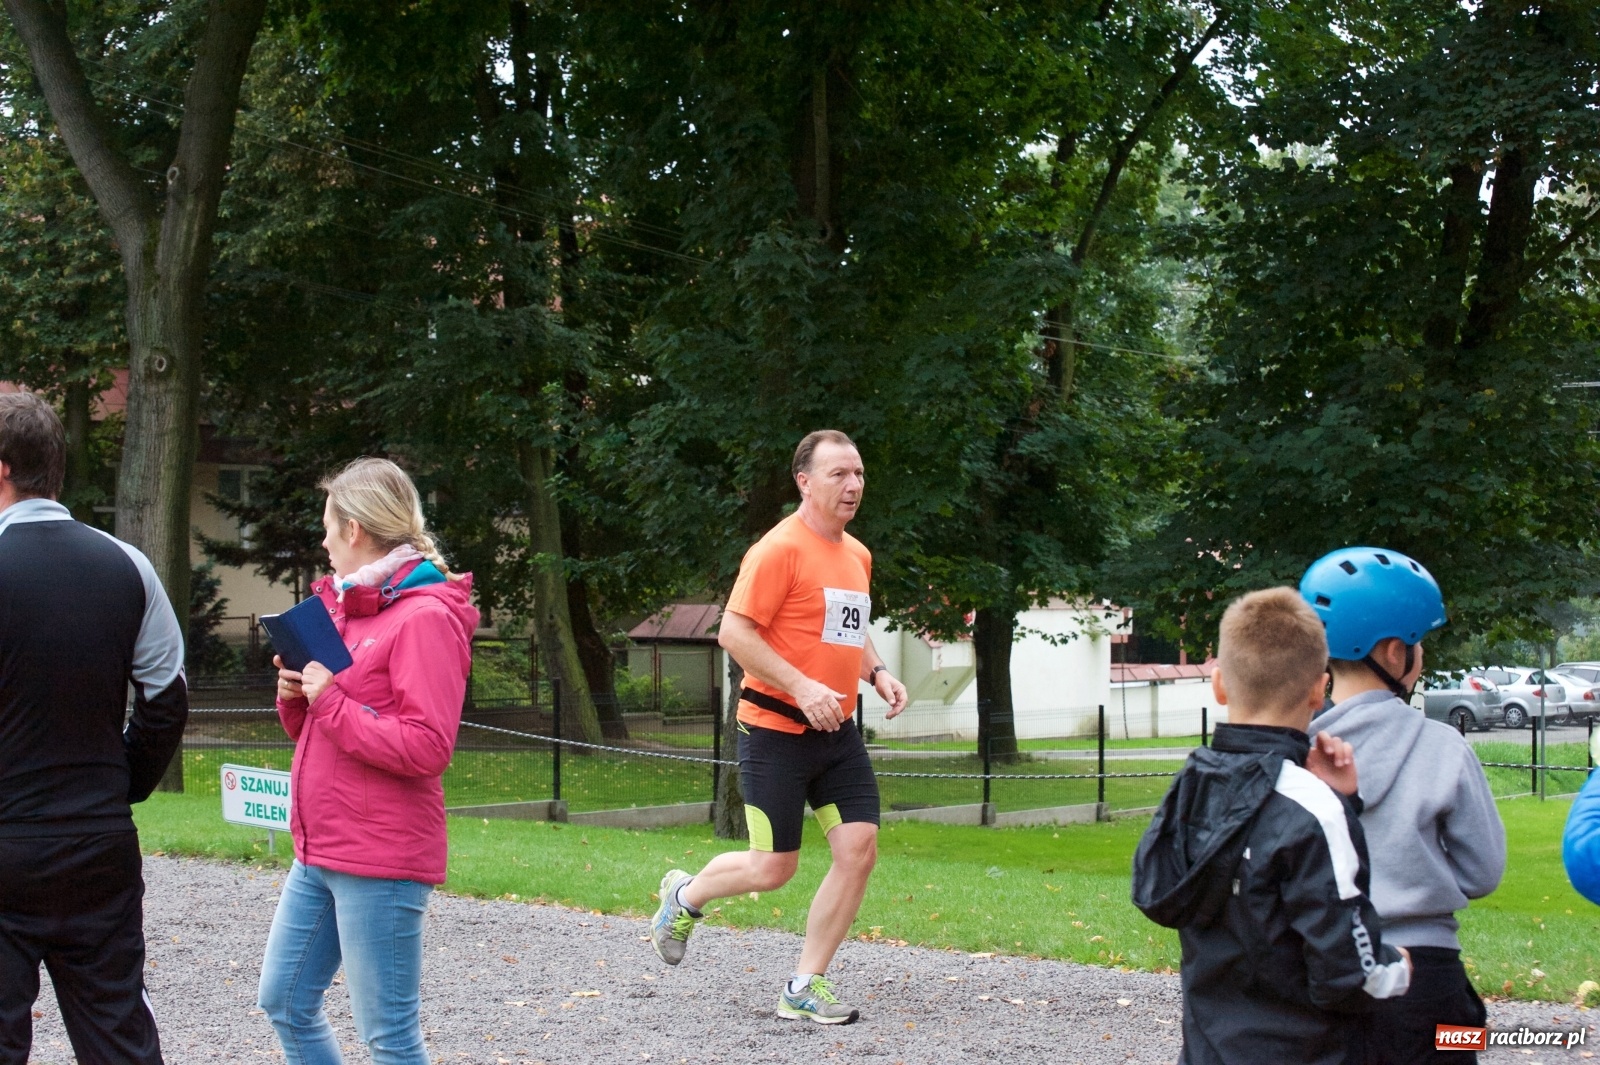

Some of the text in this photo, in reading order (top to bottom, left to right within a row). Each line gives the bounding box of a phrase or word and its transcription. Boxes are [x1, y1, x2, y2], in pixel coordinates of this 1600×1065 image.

[842, 606, 860, 630] 29
[240, 775, 288, 797] SZANUJ
[244, 802, 287, 822] ZIELEŃ
